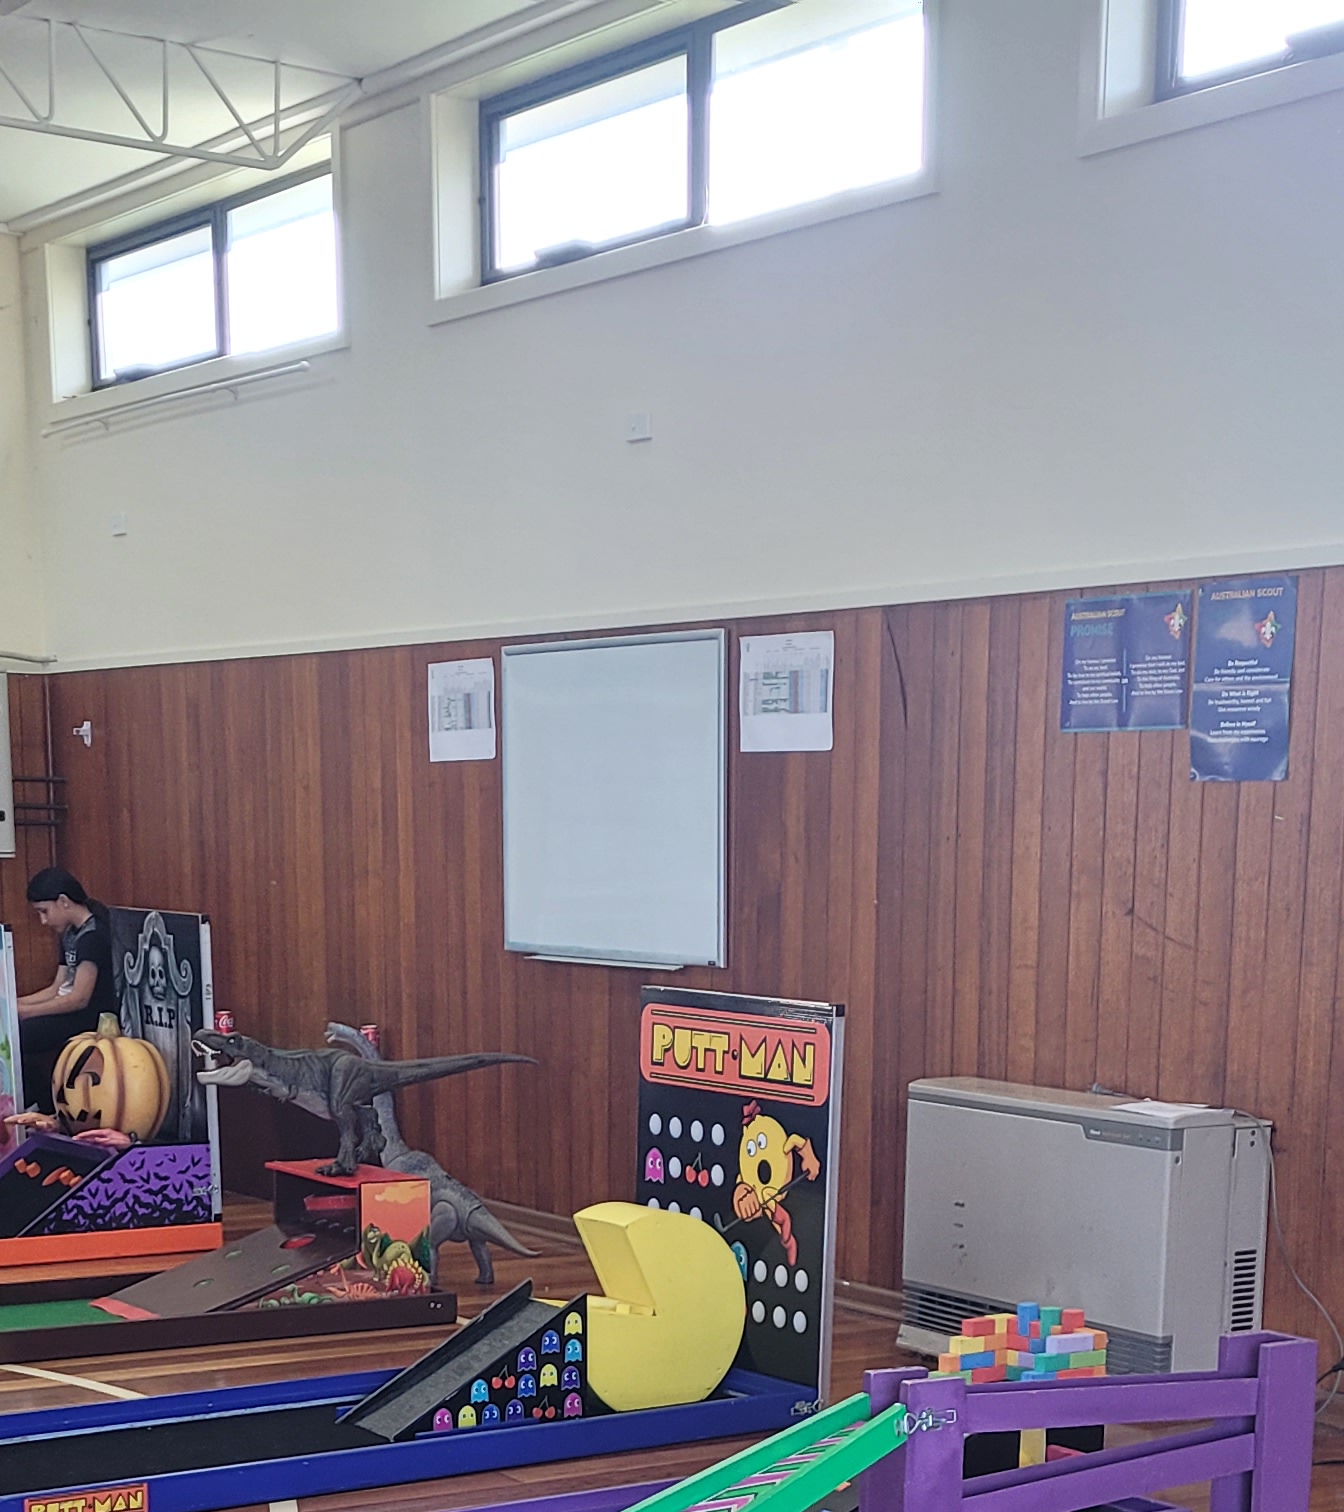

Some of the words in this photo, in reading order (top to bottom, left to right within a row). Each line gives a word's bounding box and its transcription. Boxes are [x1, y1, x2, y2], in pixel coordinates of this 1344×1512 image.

[1211, 587, 1255, 600] AUSTRALIAN
[1257, 587, 1283, 597] SCOUT
[1070, 622, 1114, 637] PROMISE
